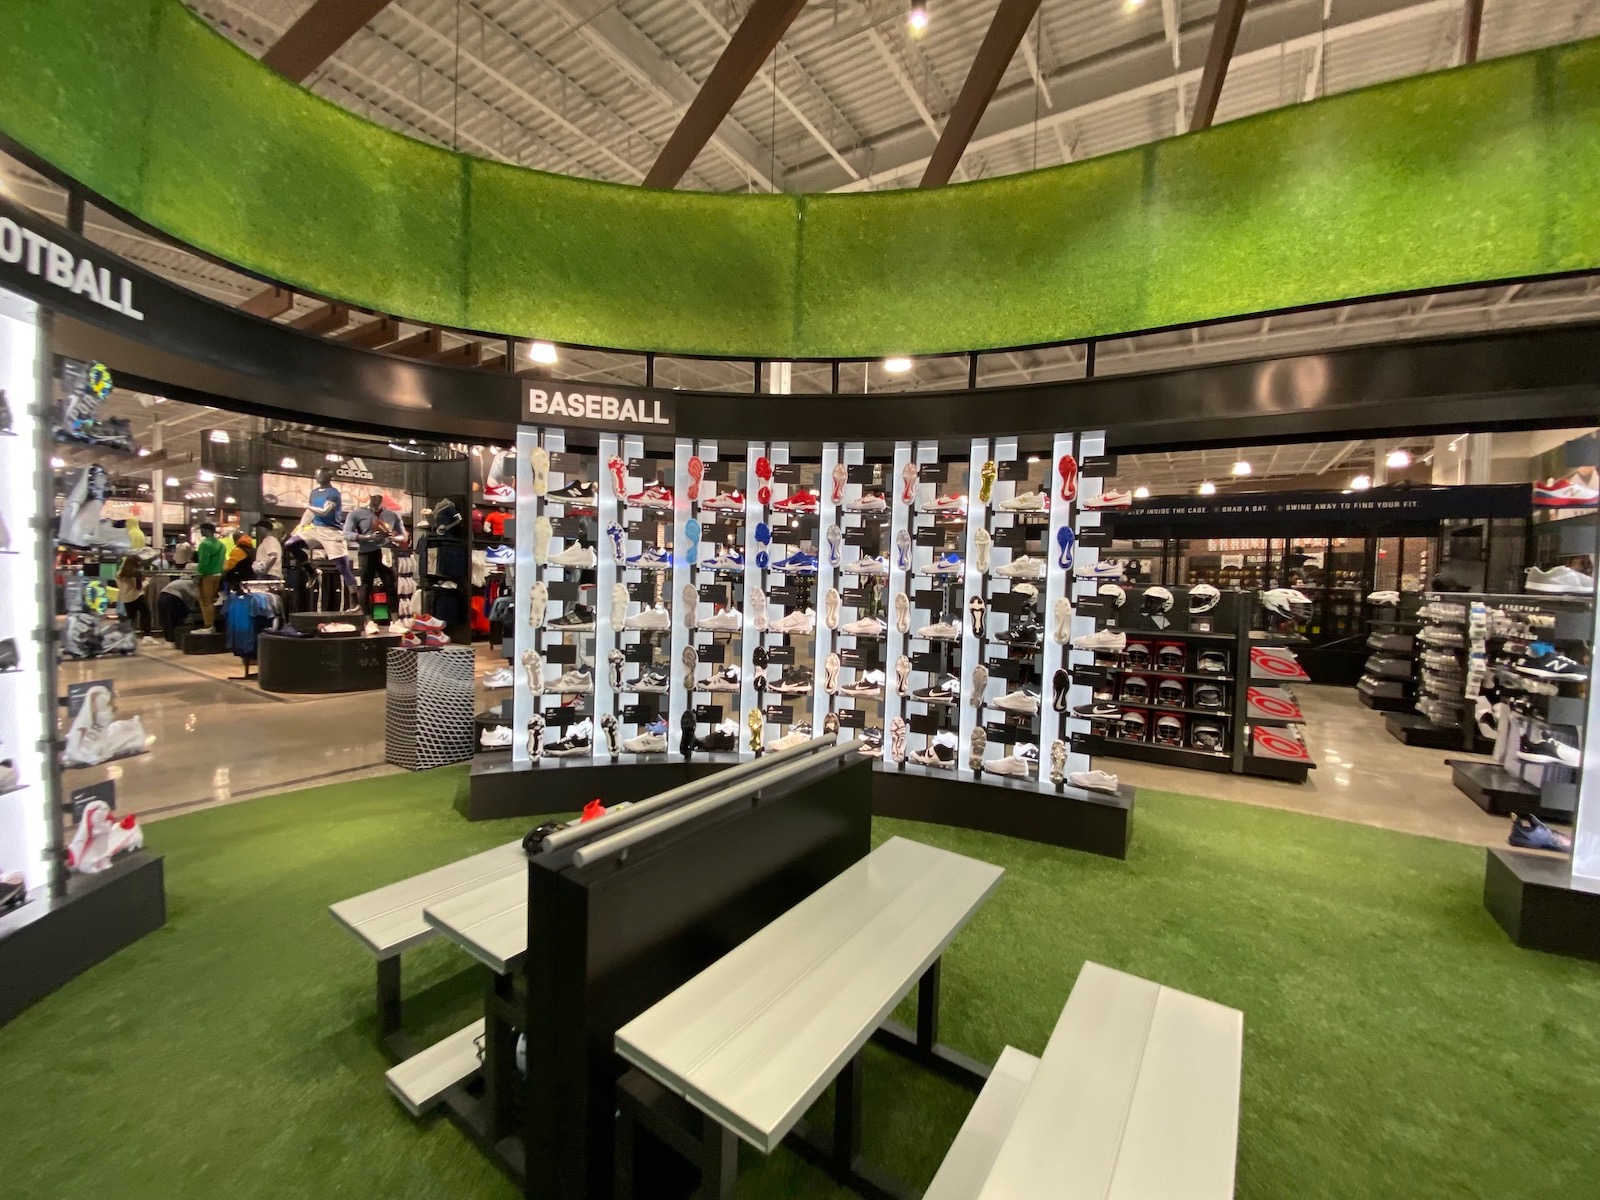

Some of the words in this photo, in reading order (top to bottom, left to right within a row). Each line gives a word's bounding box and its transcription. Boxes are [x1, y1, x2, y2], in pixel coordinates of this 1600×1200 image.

[0, 216, 144, 321] OTBALL
[529, 388, 670, 424] BASEBALL
[336, 468, 374, 480] adidas
[1146, 507, 1170, 515] INSIDE
[1222, 505, 1242, 513] GRAB
[1285, 503, 1312, 511] SWING
[1314, 502, 1337, 510] AWAY
[1353, 501, 1374, 509] FIND
